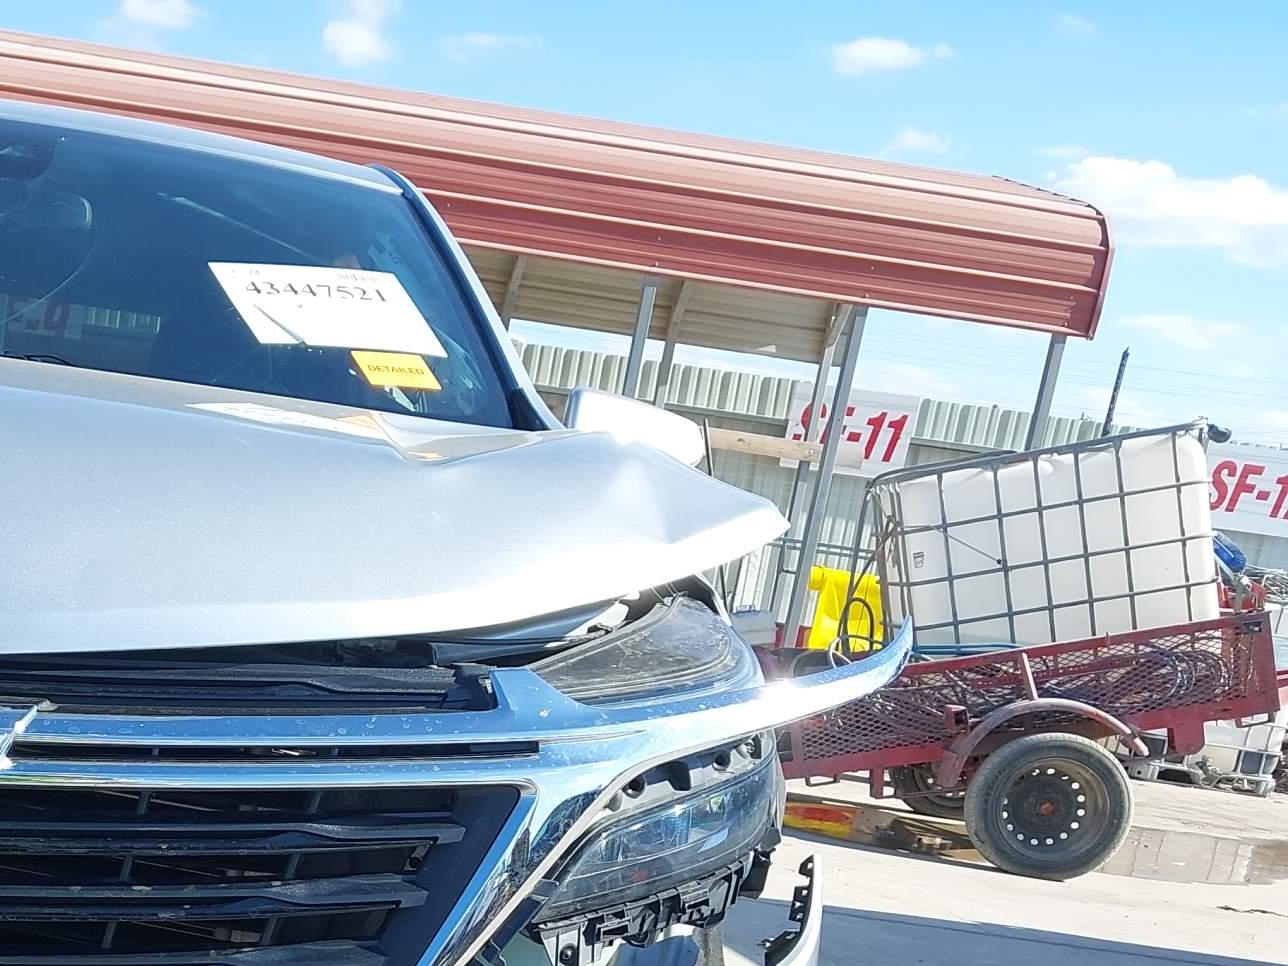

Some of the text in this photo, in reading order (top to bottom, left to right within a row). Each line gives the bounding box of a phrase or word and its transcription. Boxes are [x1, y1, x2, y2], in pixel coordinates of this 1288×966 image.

[245, 280, 387, 302] 43447521
[367, 363, 425, 376] DETAILED
[1209, 460, 1288, 520] SF-1
